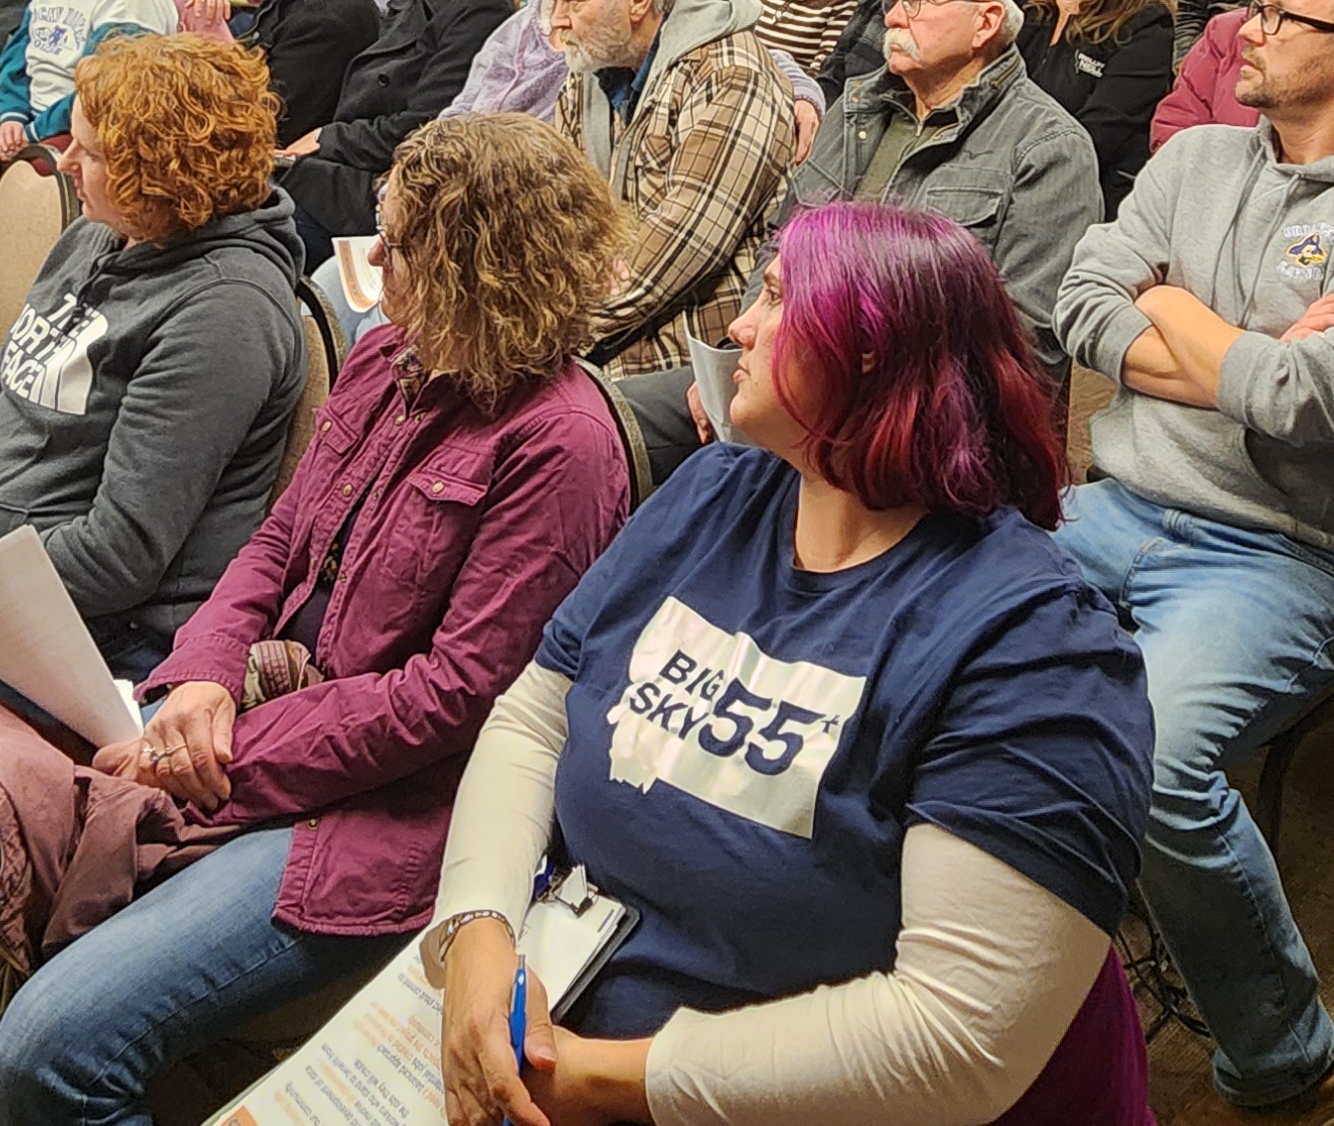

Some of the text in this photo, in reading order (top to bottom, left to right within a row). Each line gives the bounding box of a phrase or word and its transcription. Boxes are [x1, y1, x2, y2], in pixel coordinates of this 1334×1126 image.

[1, 341, 44, 399] FACE
[658, 648, 724, 701] BIG
[629, 682, 711, 741] SKY
[318, 1043, 335, 1060] from
[374, 1043, 403, 1070] approach
[302, 1064, 319, 1081] data
[330, 1056, 352, 1078] benefit
[408, 1055, 427, 1074] jobs
[348, 1074, 357, 1084] to
[365, 1074, 379, 1087] will
[396, 1064, 425, 1093] balanced
[353, 1080, 370, 1098] stand
[375, 1081, 392, 1099] they
[319, 1084, 353, 1121] development
[366, 1094, 381, 1109] who
[386, 1093, 403, 1109] jobs
[396, 1105, 409, 1118] the
